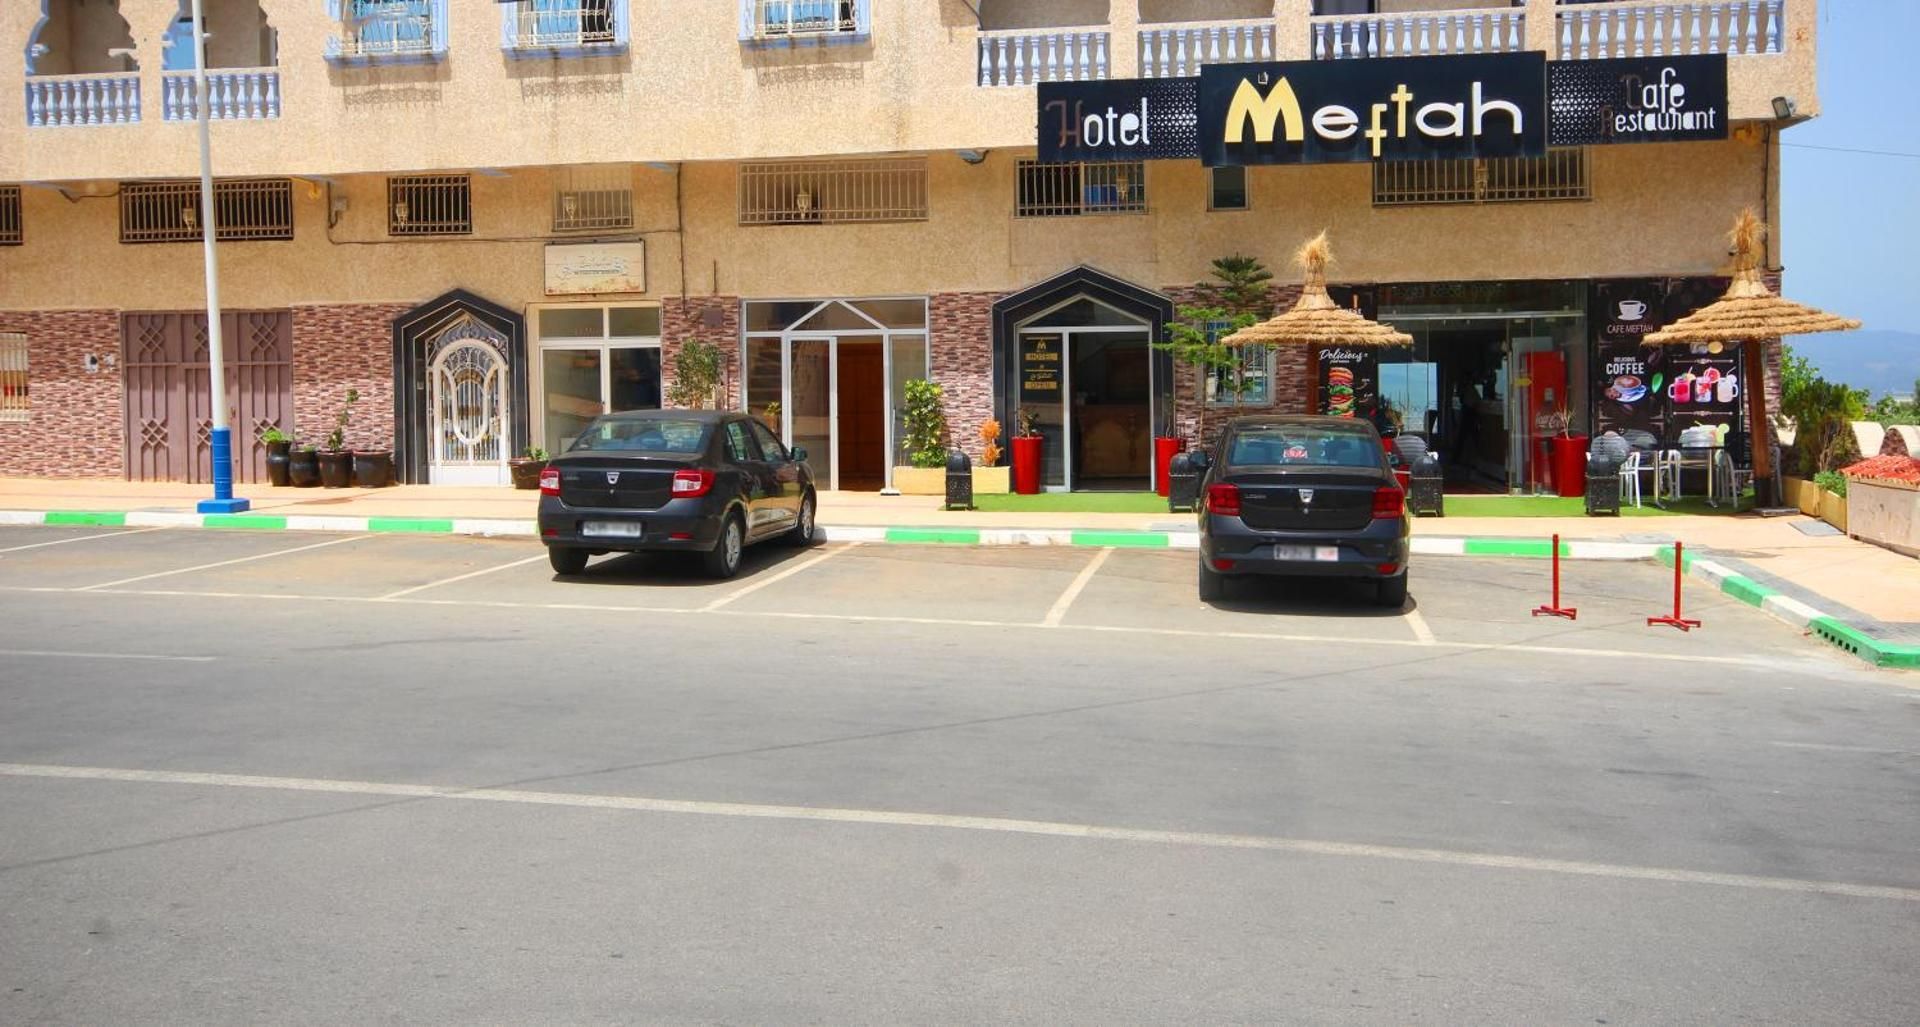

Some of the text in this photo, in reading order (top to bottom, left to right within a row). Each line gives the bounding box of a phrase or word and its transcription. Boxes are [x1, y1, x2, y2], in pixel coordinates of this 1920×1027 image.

[1621, 67, 1686, 113] Cafe
[1045, 97, 1151, 148] Hotel
[1224, 76, 1523, 158] Meftah
[1600, 105, 1717, 137] Restaurant
[1607, 323, 1654, 334] CAFE MEFTAH
[1606, 363, 1645, 375] COFFEE
